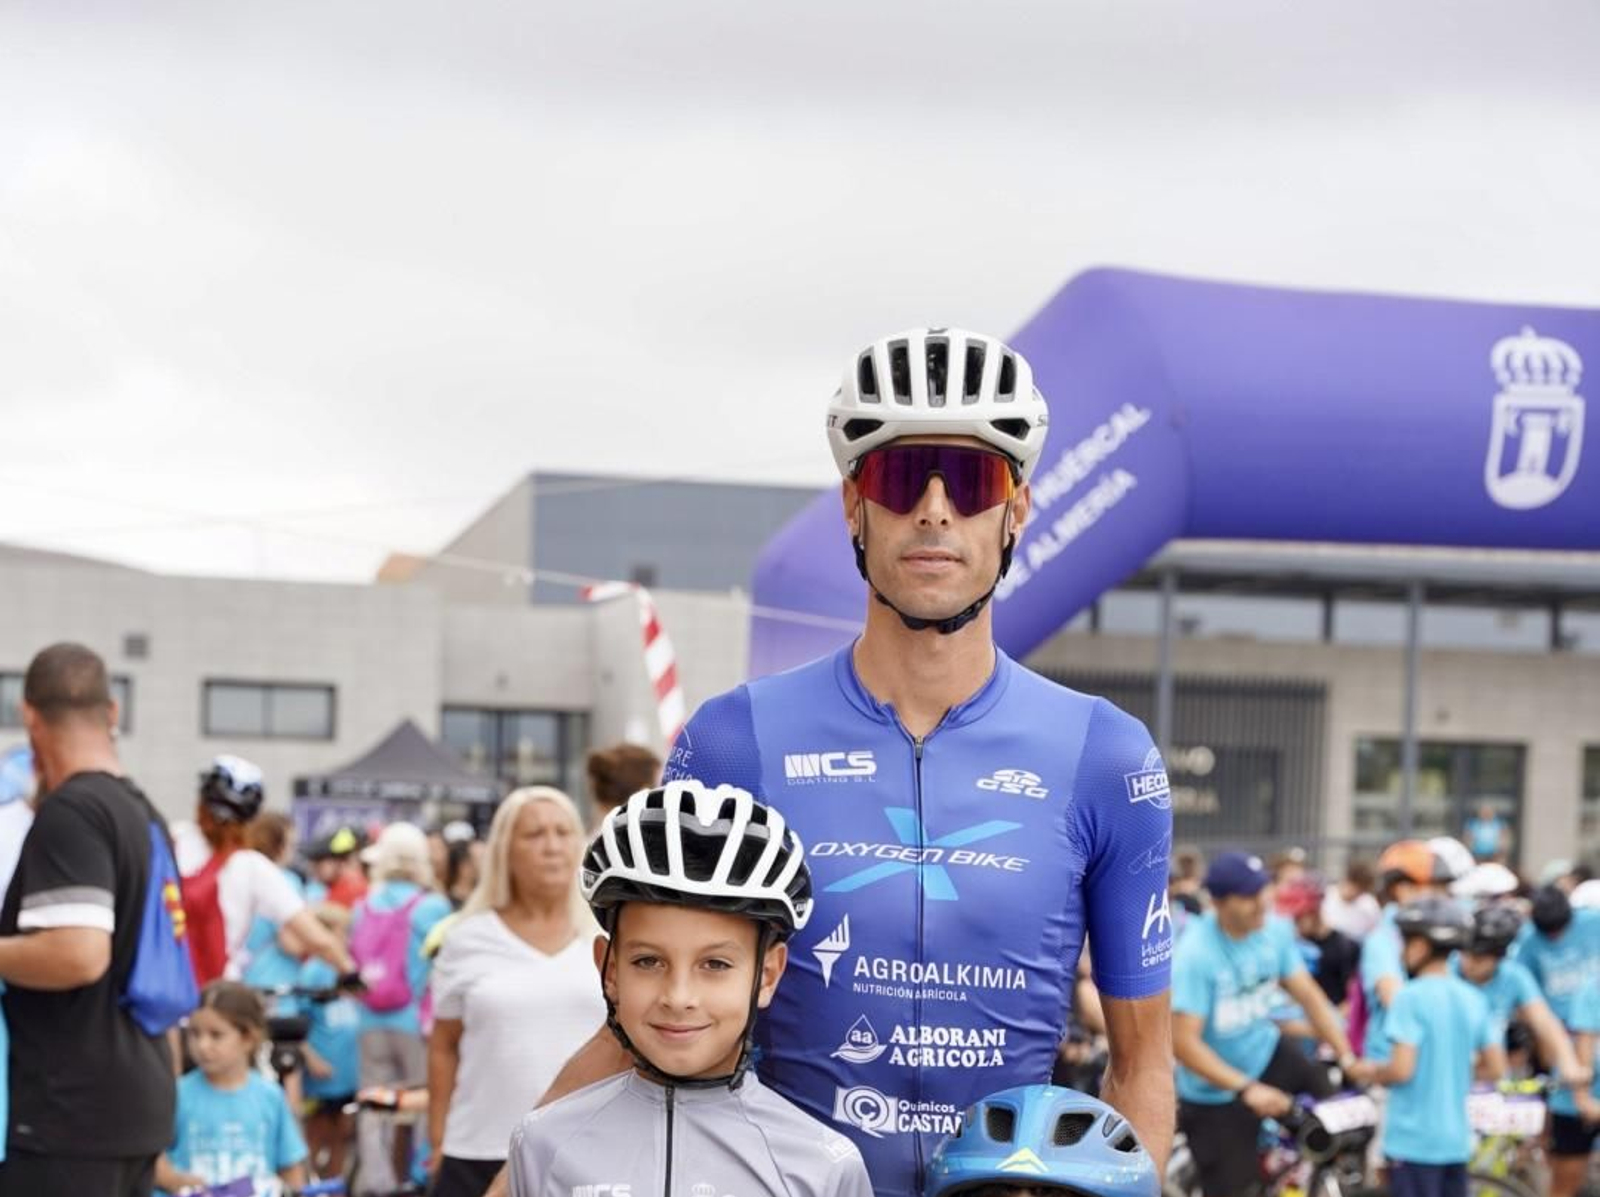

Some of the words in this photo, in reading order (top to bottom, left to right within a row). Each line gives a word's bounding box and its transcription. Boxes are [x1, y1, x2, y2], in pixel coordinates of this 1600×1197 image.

[810, 842, 944, 863] OXYGEN
[948, 850, 1031, 872] BIKE
[853, 955, 1027, 990] AGROALKIMIA
[889, 1025, 1006, 1047] ALBORANI
[888, 1046, 1004, 1067] AGRICOLA
[898, 1111, 966, 1134] CASTAÑ
